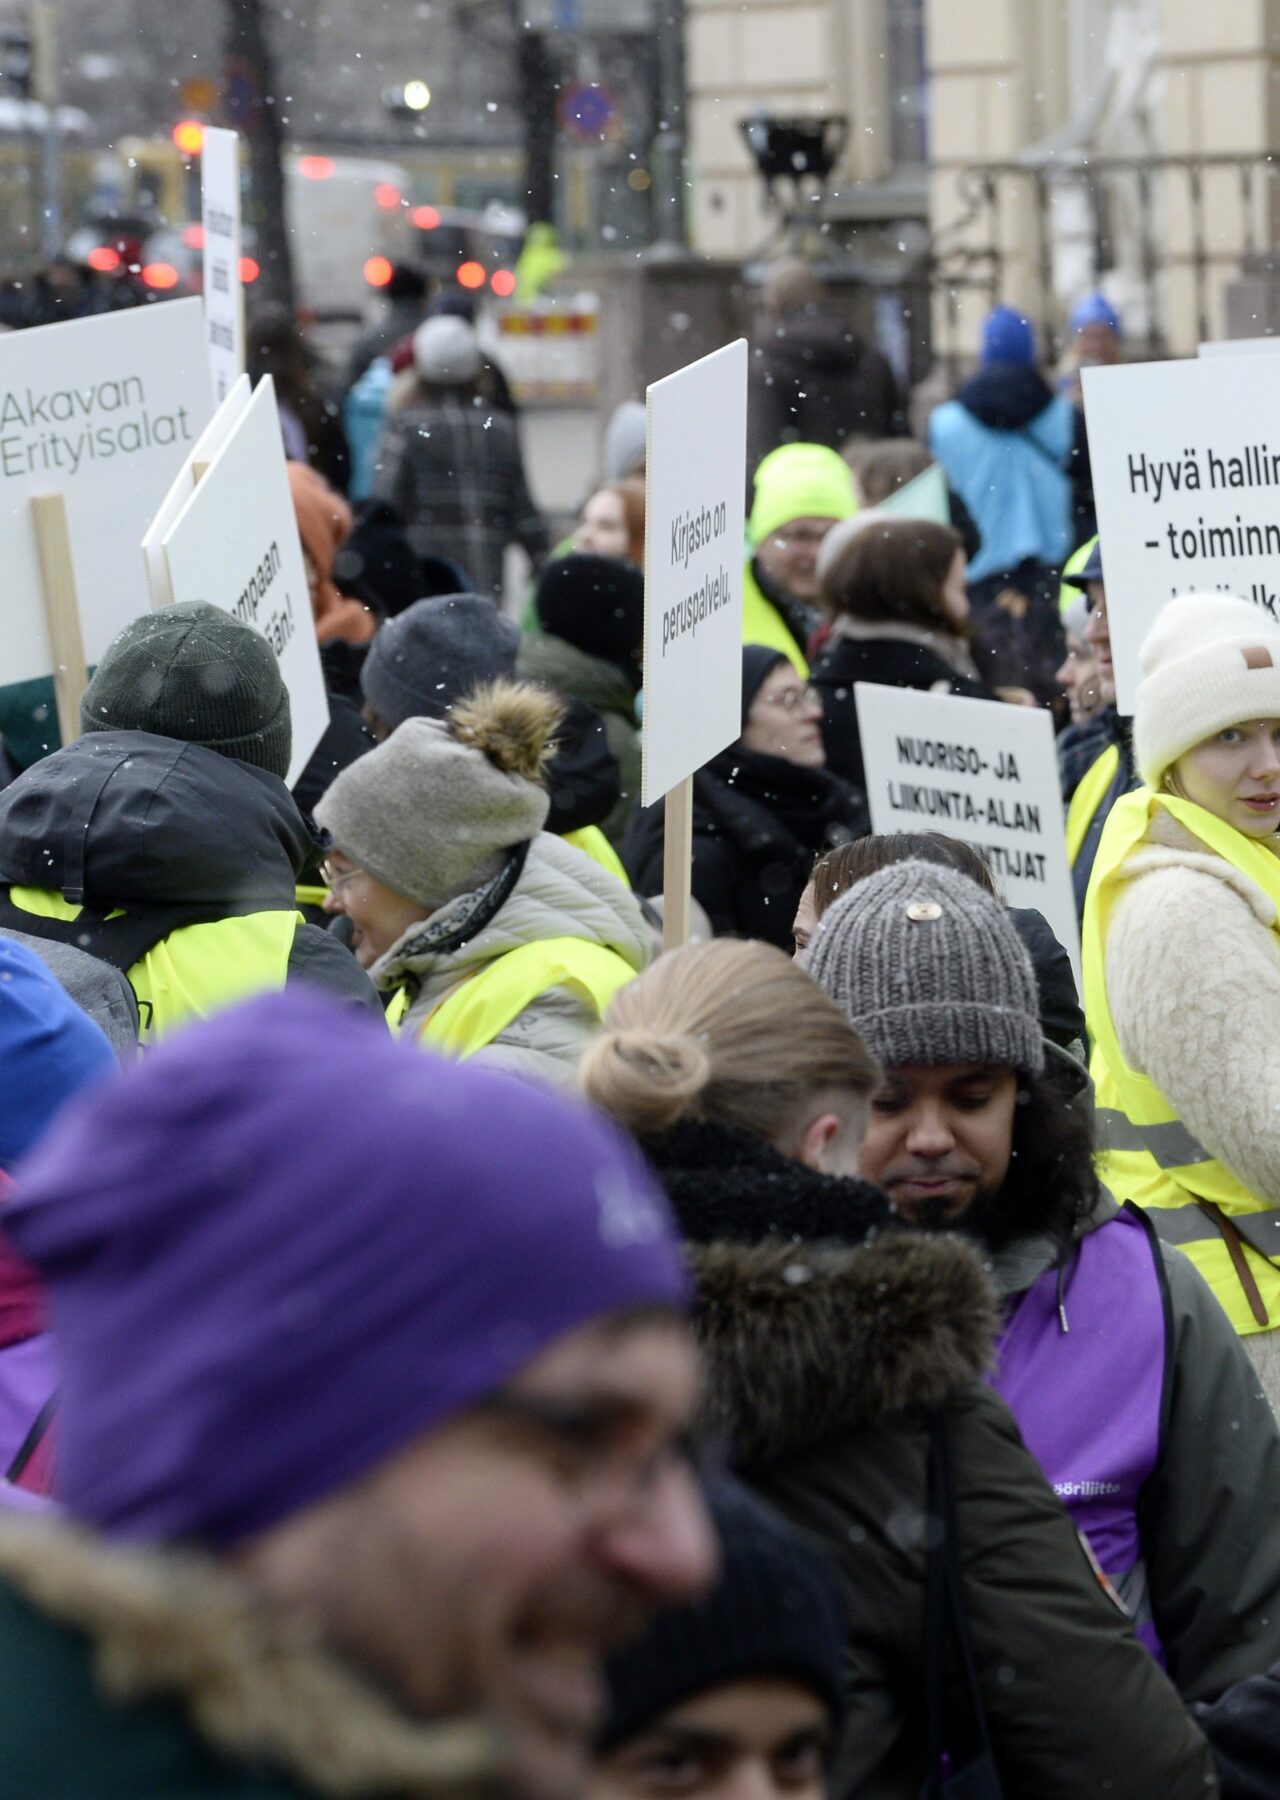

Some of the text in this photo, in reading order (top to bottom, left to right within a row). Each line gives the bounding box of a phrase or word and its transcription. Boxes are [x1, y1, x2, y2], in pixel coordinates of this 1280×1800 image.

[0, 376, 144, 432] Akavan
[1, 405, 192, 477] Erityisalat
[1128, 448, 1201, 502] Hyvä
[671, 501, 726, 569] Kirjasto on
[232, 540, 281, 622] mpaan
[662, 564, 731, 658] peruspalvelu.
[896, 736, 1021, 783] NUORISO- JA
[888, 780, 1042, 835] LIIKUNTA-ALAN
